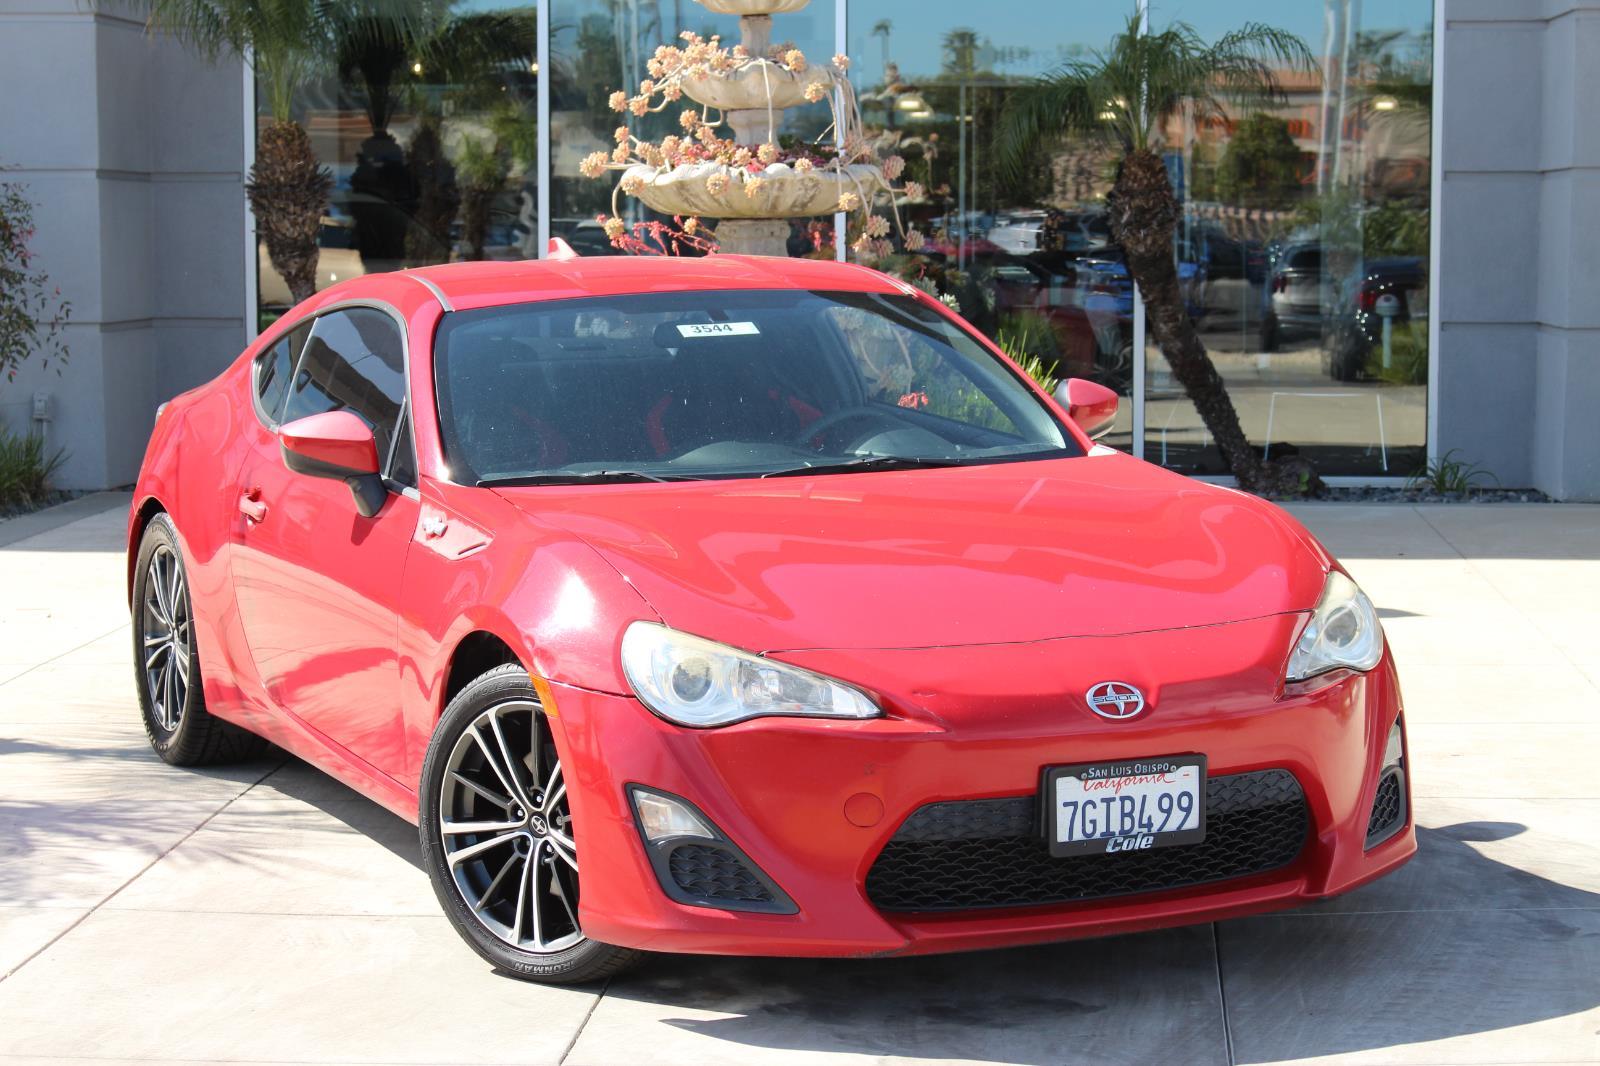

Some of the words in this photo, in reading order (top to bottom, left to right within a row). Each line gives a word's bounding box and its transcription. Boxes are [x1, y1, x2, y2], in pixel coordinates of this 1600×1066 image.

[690, 324, 733, 334] 3544
[1062, 790, 1194, 841] 7GIB499
[1105, 831, 1154, 853] Cole
